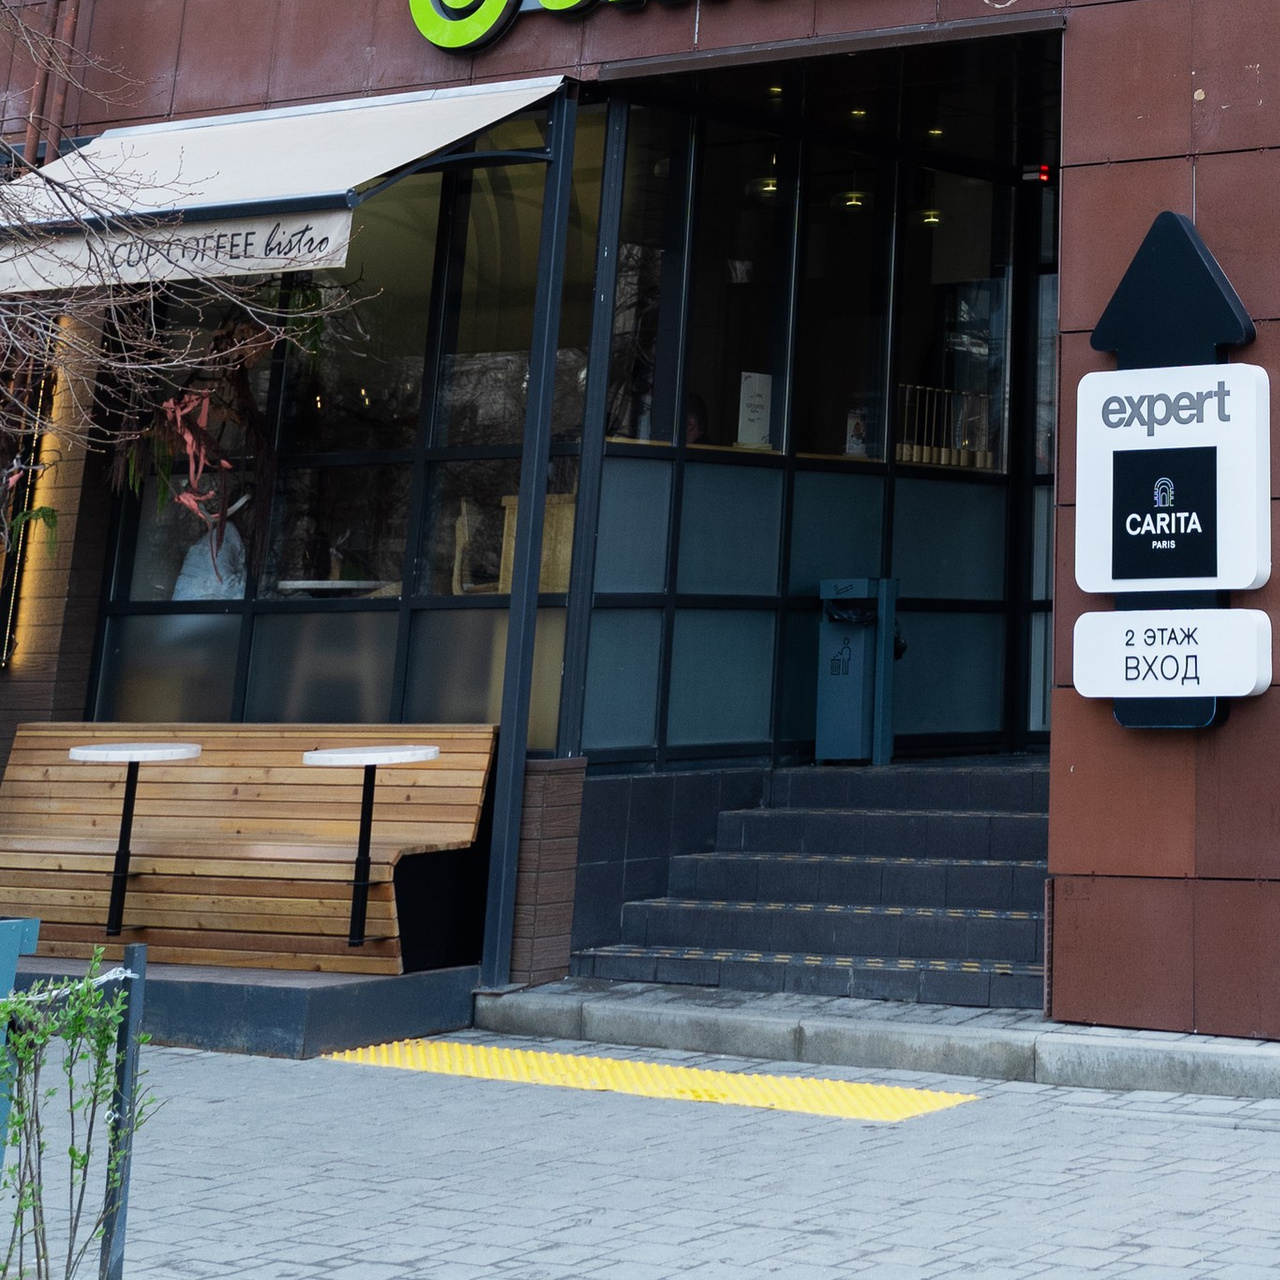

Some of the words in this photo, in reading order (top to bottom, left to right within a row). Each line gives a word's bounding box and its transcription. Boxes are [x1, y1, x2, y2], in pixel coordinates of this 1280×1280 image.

[112, 239, 159, 268] CUP
[264, 222, 329, 257] bistro
[1101, 380, 1231, 437] expert
[1125, 511, 1203, 536] CARITA
[1151, 540, 1176, 550] PARIS
[1124, 628, 1136, 647] 2
[1143, 626, 1199, 646] ЭТАЖ
[1124, 654, 1201, 686] ВХОД
